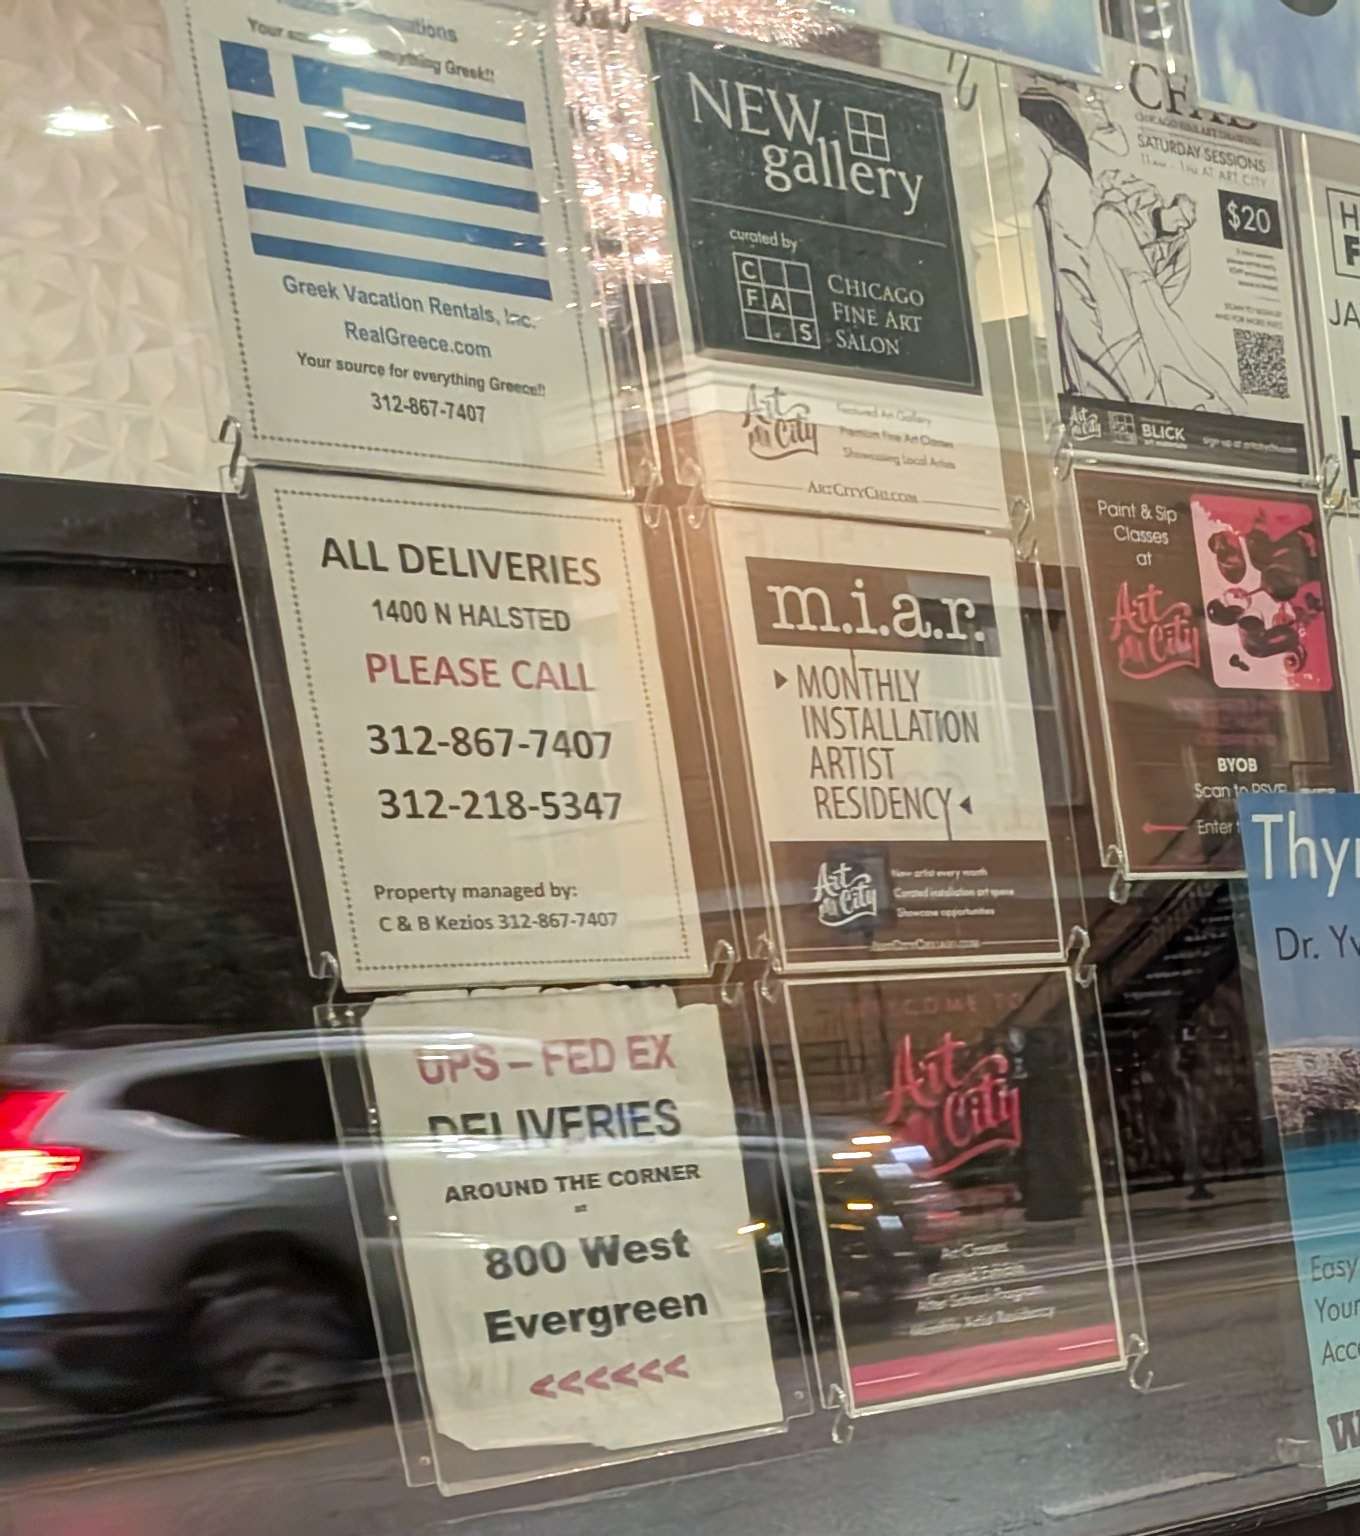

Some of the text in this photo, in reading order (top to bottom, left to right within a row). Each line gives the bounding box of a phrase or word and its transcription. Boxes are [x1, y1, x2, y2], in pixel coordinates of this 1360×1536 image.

[688, 71, 822, 146] NEW
[1137, 133, 1200, 159] SATURDAY
[1204, 147, 1266, 173] SESSIONS
[762, 137, 923, 216] gallery
[1227, 200, 1271, 233] $20
[729, 228, 797, 253] curated by
[282, 274, 340, 300] Greek
[343, 283, 424, 313] Vacation
[429, 297, 500, 325] Rentals,
[828, 274, 924, 307] CHICAGO
[833, 302, 923, 333] FINE ART
[344, 321, 492, 358] RealGreece.com
[836, 330, 901, 355] SALON
[297, 351, 331, 369] Your
[336, 356, 385, 376] source
[389, 363, 408, 379] for
[413, 369, 485, 392] everything
[371, 392, 486, 423] 312-867-7407
[1140, 423, 1185, 442] BLICK
[1097, 499, 1178, 524] Paint & Sip
[1114, 525, 1169, 545] Classes
[321, 537, 602, 587] ALL DELIVERIES
[1136, 551, 1153, 567] at
[372, 599, 571, 632] 1400 N HALSTED
[766, 578, 986, 642] m.i.a.r.
[1110, 581, 1170, 641] Art
[365, 653, 596, 692] PLEASE CALL
[797, 664, 920, 702] MONTHLY
[366, 724, 612, 759] 312-867-7407
[801, 705, 980, 743] INSTALLATION
[810, 746, 895, 780] ARTIST
[1217, 757, 1258, 773] BYOB
[377, 788, 622, 820] 312-218-5347
[813, 786, 952, 823] RESIDENCY
[1194, 782, 1231, 799] Scan
[1197, 819, 1233, 836] Enter
[374, 881, 578, 903] Property managed by:
[813, 861, 852, 903] Art
[379, 912, 618, 932] C & B Kezios 312-867-7407
[1275, 927, 1320, 961] Dr.
[415, 1033, 678, 1086] UPS FED EX
[882, 1031, 968, 1124] Art
[428, 1098, 682, 1142] DELIVERIES
[445, 1163, 702, 1204] AROUND THE CORNER
[484, 1228, 691, 1281] 800 West
[1310, 1255, 1358, 1283] Easy
[484, 1292, 709, 1345] Evergreen
